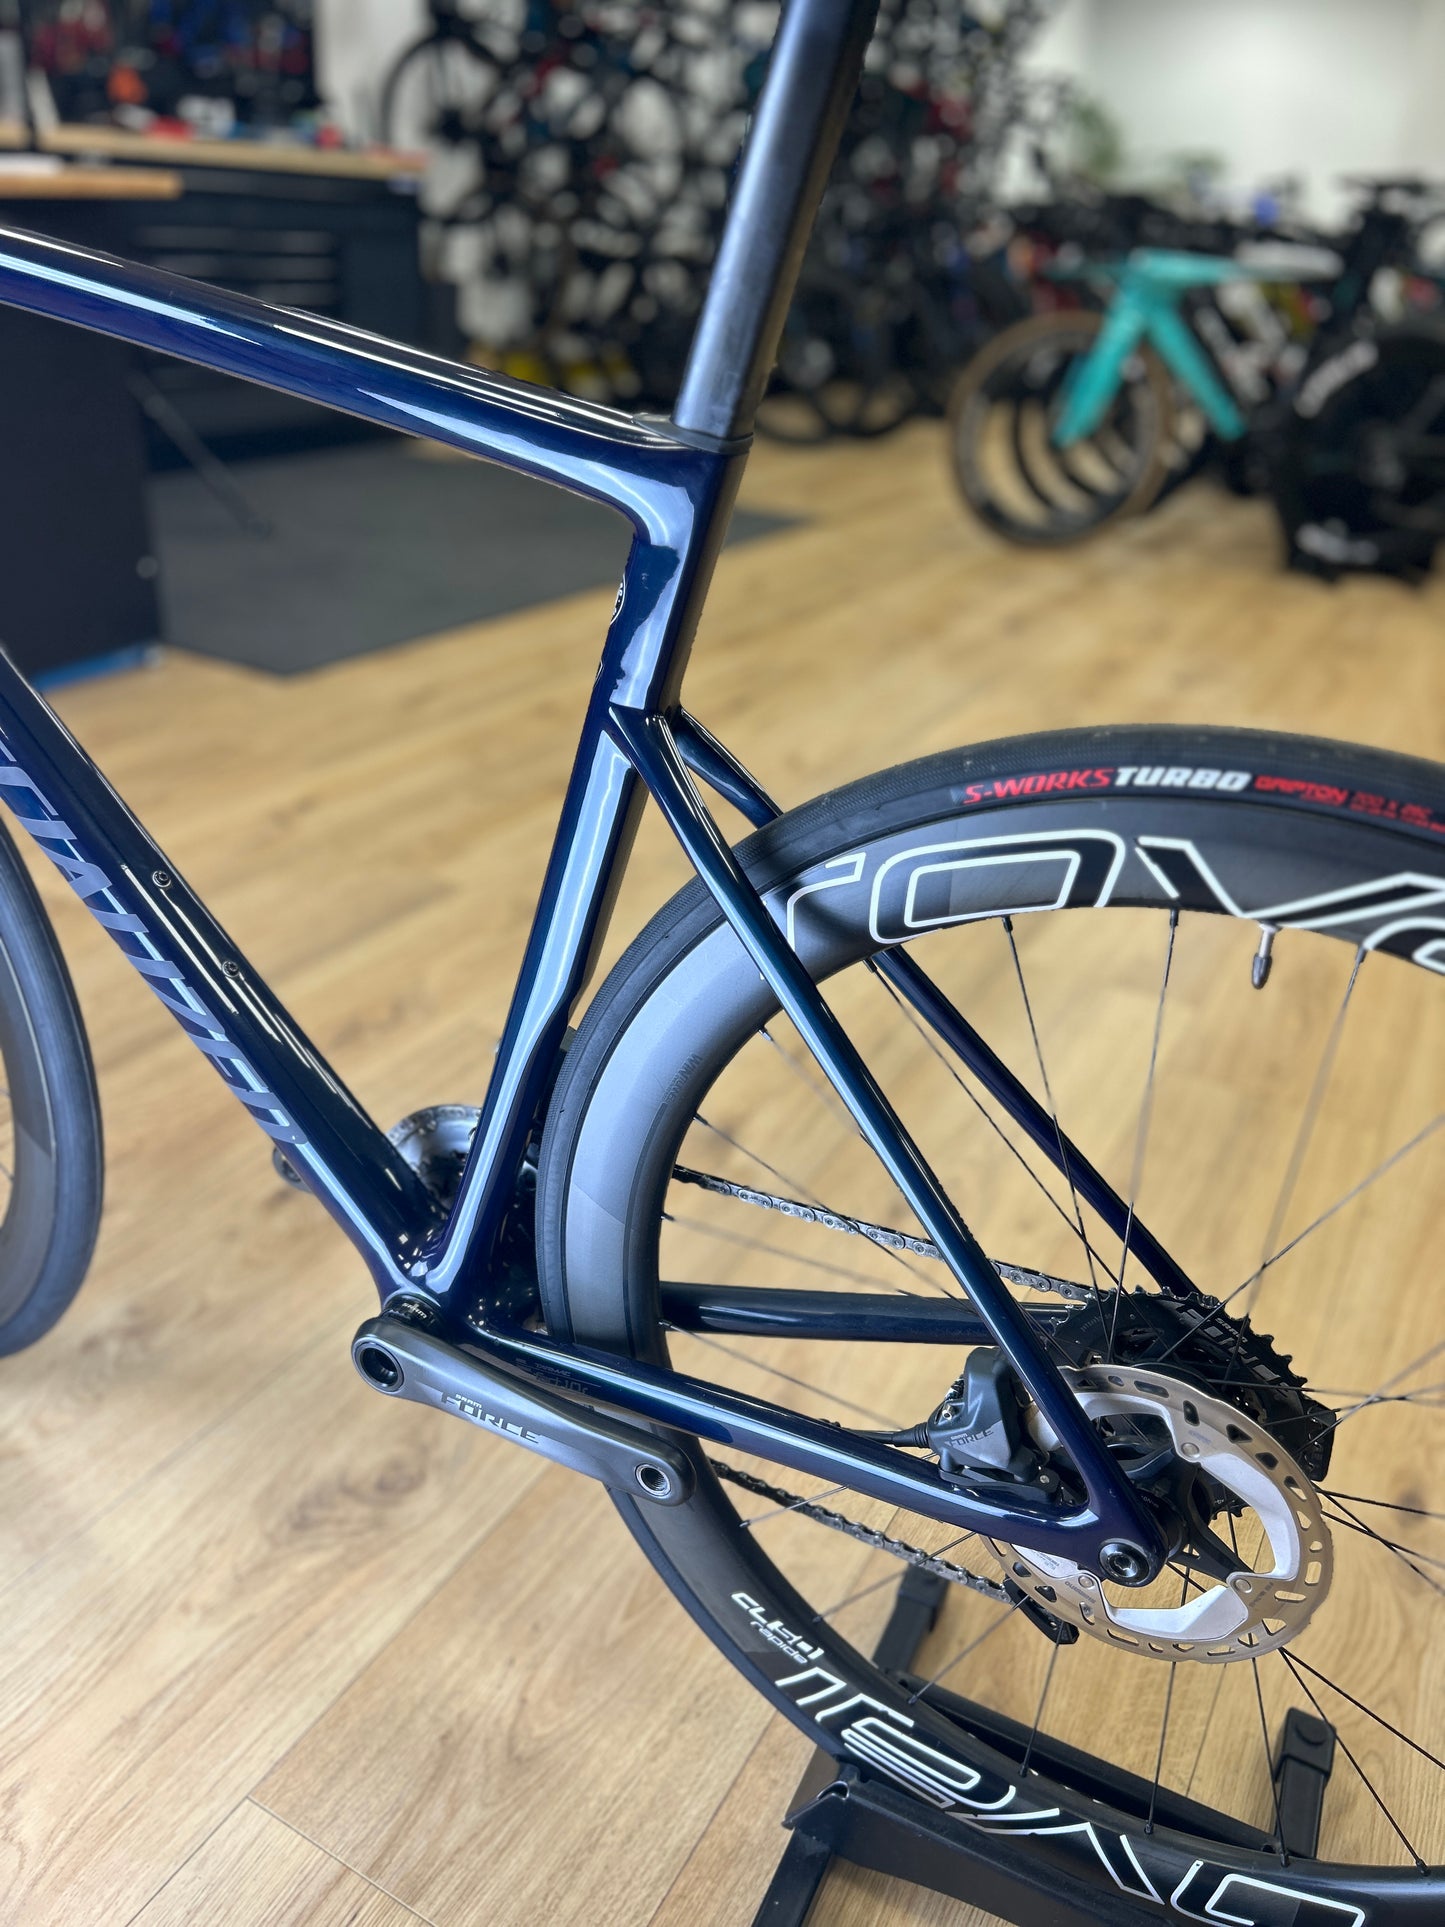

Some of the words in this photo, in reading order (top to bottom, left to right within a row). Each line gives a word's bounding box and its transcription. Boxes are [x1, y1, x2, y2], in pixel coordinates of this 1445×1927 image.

[963, 769, 1114, 804] S-WORKS
[1114, 766, 1252, 791] TURBO
[441, 1391, 539, 1444] FORCE
[750, 1620, 808, 1664] rapide
